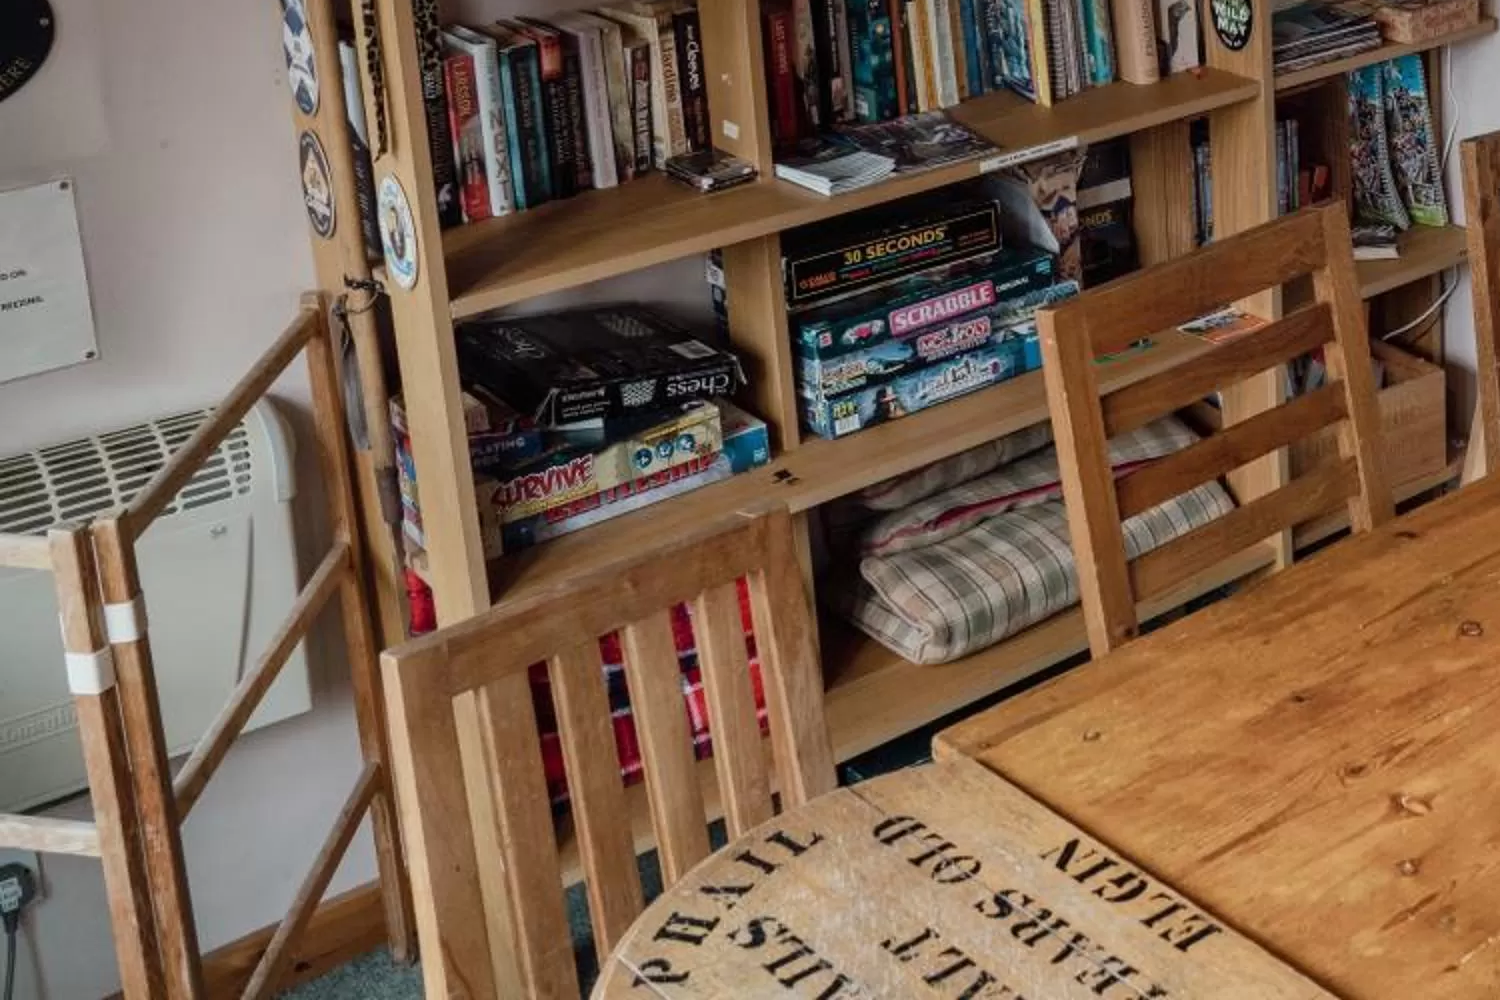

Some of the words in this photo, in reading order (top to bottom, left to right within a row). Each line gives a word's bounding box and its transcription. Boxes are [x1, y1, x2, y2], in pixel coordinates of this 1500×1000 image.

[844, 248, 862, 265] 30
[866, 225, 946, 260] SECONDS
[893, 283, 994, 331] SCRABBLE
[666, 374, 731, 401] Chess
[871, 814, 983, 887] OLD
[1039, 836, 1224, 955] ELGIN
[882, 926, 1025, 1000] ALT
